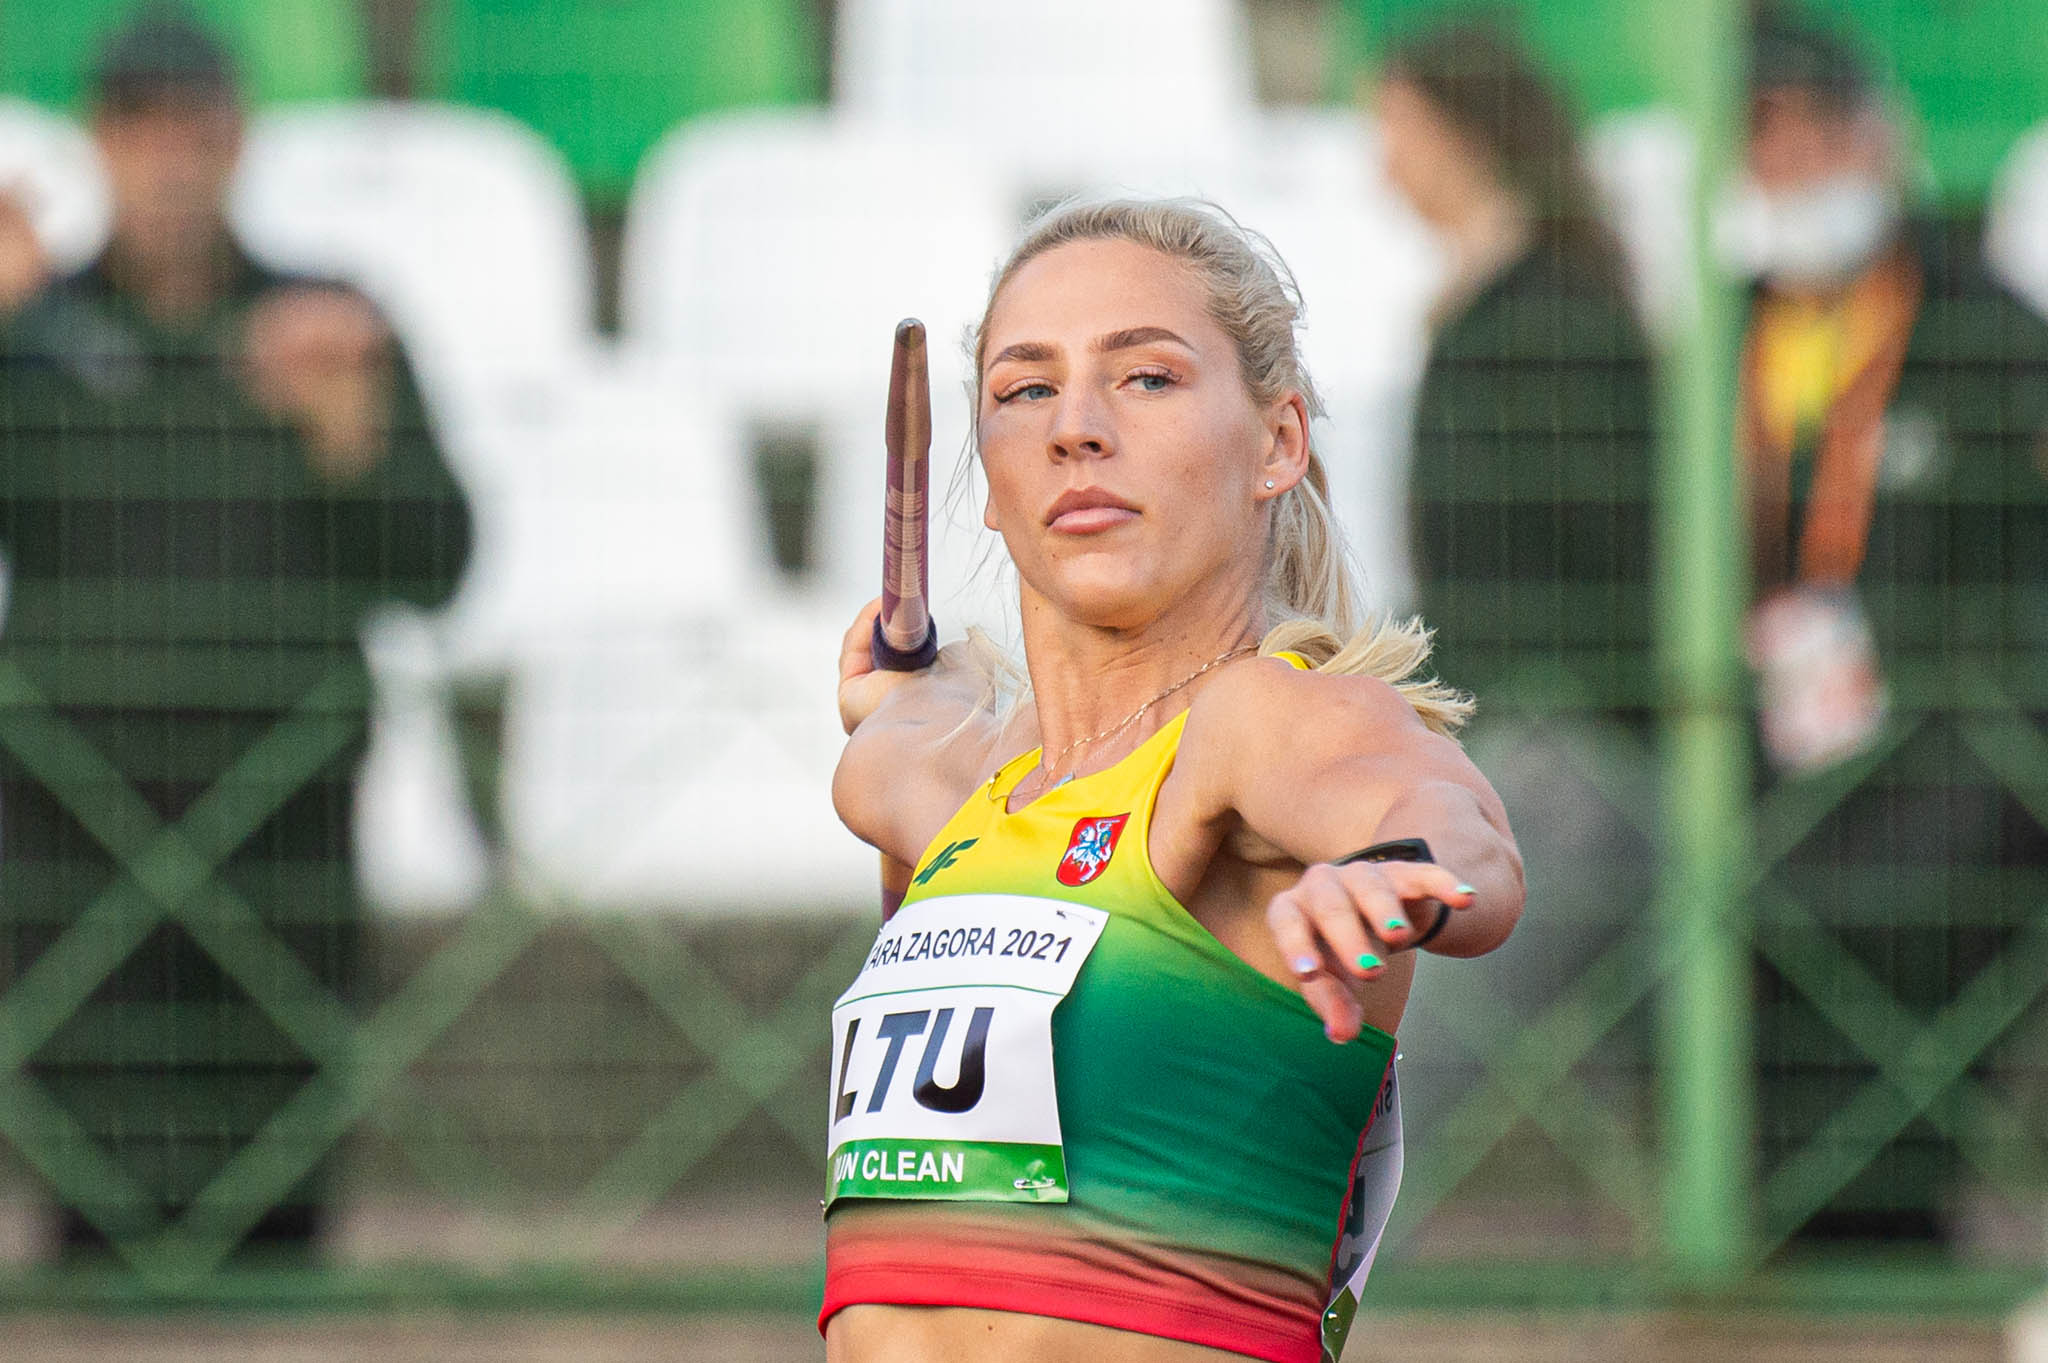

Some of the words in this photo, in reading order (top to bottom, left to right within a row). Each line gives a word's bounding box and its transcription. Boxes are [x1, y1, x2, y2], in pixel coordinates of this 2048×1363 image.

[903, 927, 996, 962] ZAGORA
[1000, 929, 1072, 963] 2021
[834, 1007, 995, 1127] LTU
[862, 1150, 964, 1183] CLEAN
